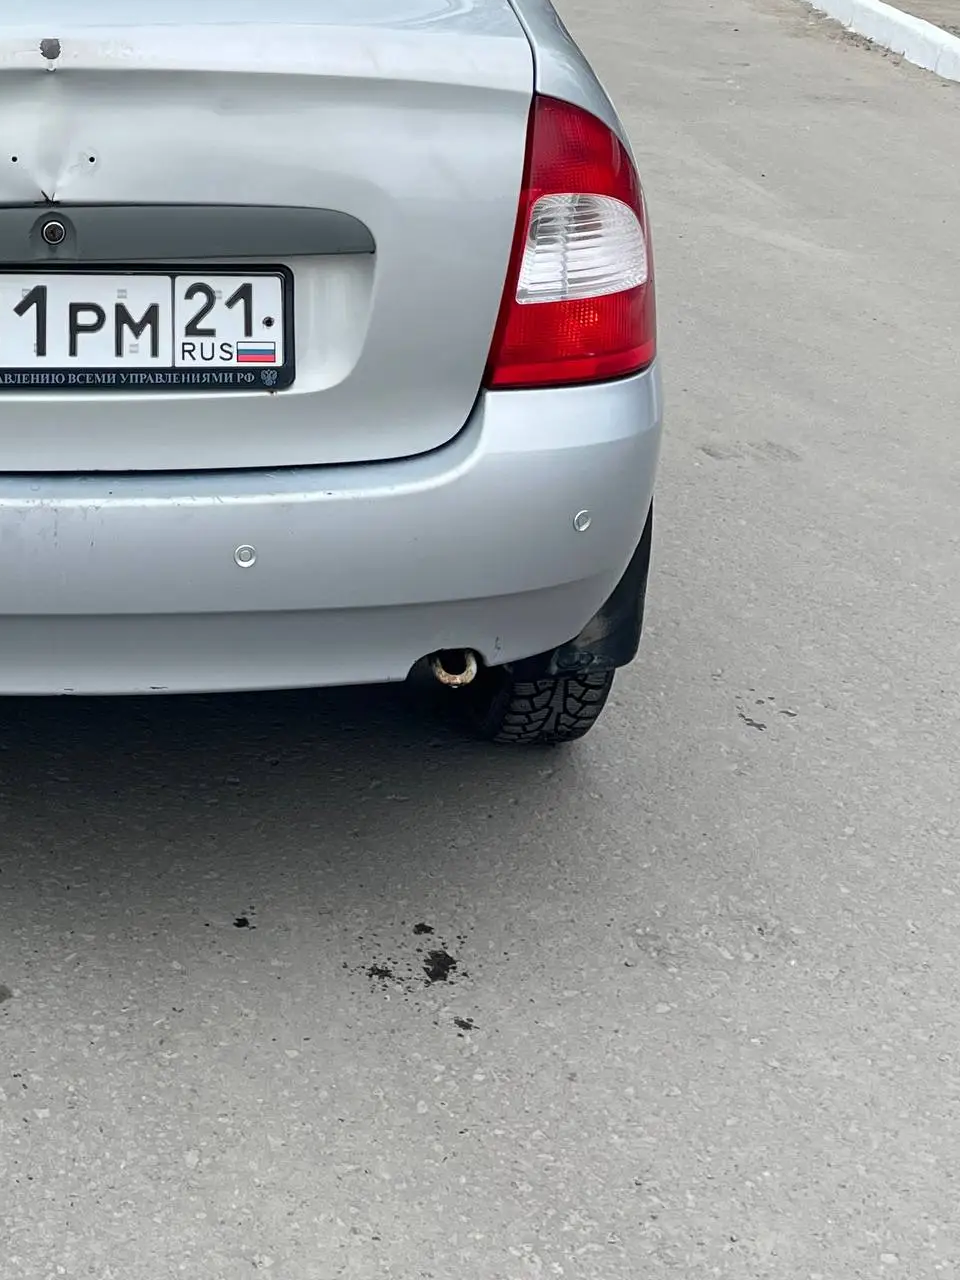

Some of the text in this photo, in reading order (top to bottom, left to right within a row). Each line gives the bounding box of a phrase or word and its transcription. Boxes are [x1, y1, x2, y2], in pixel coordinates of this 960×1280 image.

[184, 282, 253, 337] 21
[181, 342, 233, 361] RUS
[70, 372, 116, 385] ВСЕМИ
[120, 372, 233, 385] УПРАВЛЕНИЯМИ
[237, 372, 255, 385] РФ
